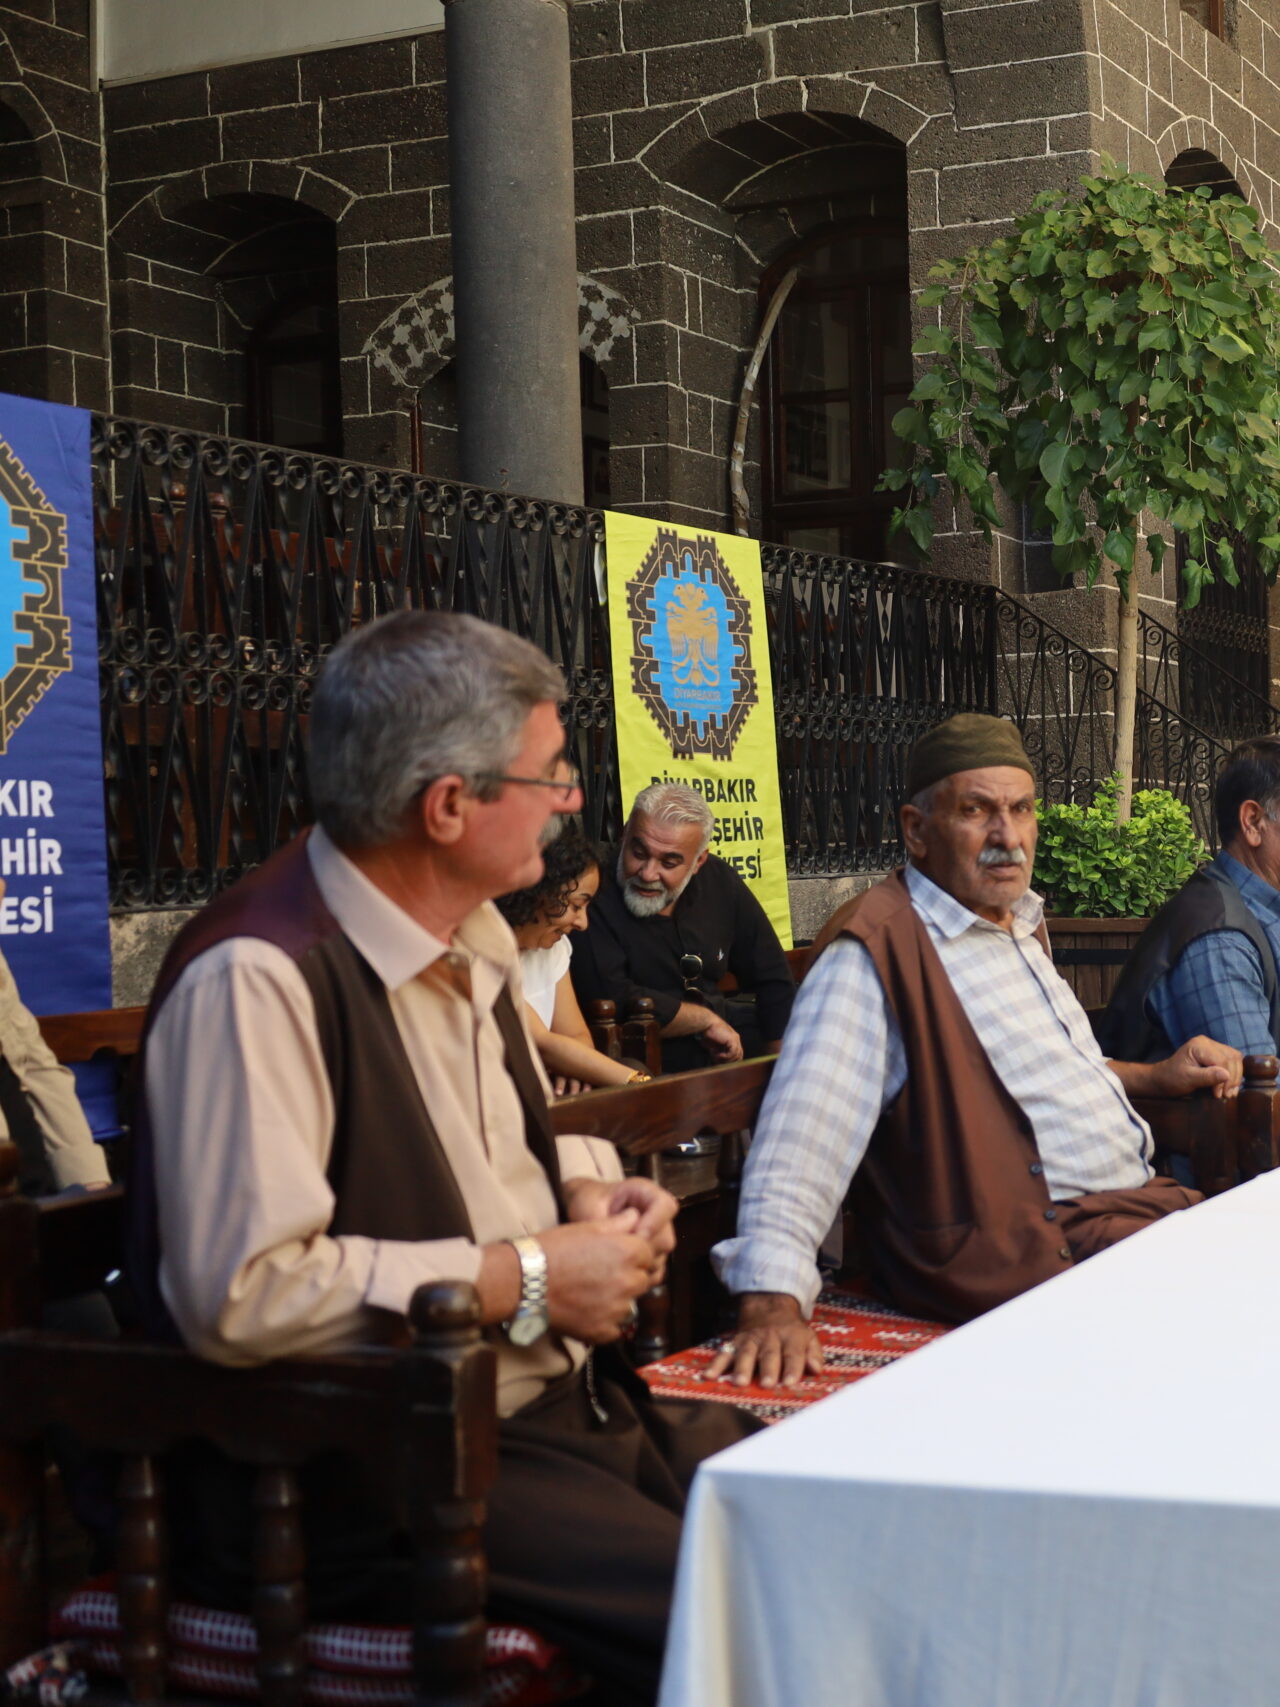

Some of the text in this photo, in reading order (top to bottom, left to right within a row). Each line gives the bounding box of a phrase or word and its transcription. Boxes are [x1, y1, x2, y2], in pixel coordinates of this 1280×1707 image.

[0, 779, 55, 817] KIR
[0, 828, 63, 875] HİR
[0, 886, 53, 934] ESİ
